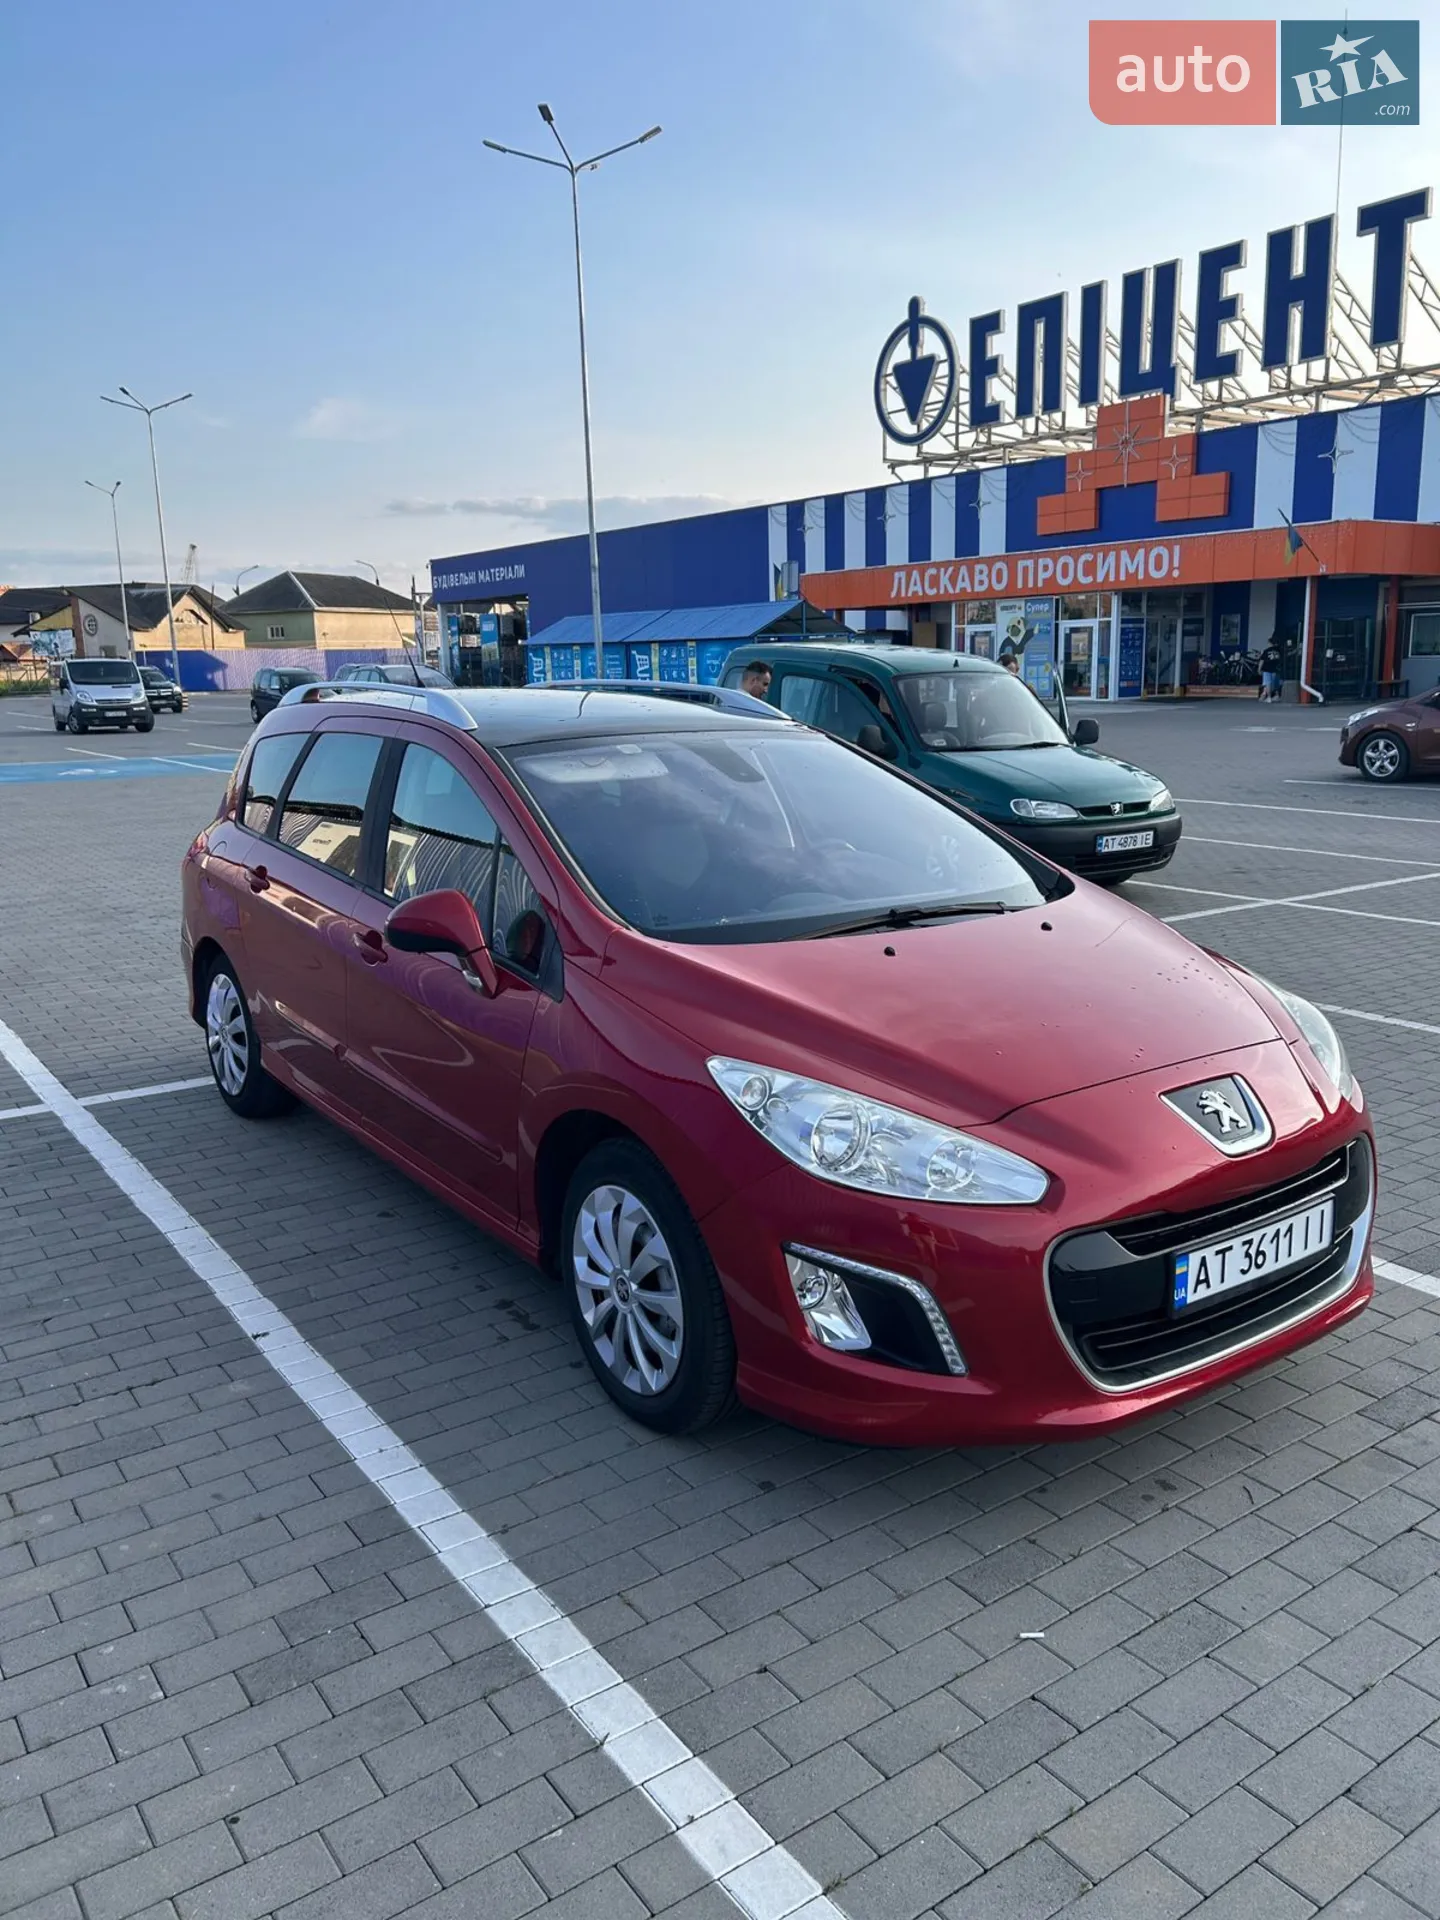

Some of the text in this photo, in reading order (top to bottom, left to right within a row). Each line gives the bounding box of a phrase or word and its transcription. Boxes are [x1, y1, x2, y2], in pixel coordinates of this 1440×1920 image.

[968, 186, 1433, 428] ЕПІЦЕНТ
[433, 564, 525, 589] БУДІВЕЛЬНІ МАТЕРІАЛИ
[890, 545, 1181, 598] ЛАСКАВО ПРОСИМО!
[1104, 833, 1151, 849] AT 4878 IE
[1193, 1246, 1233, 1293] AT
[1239, 1222, 1295, 1275] 3611
